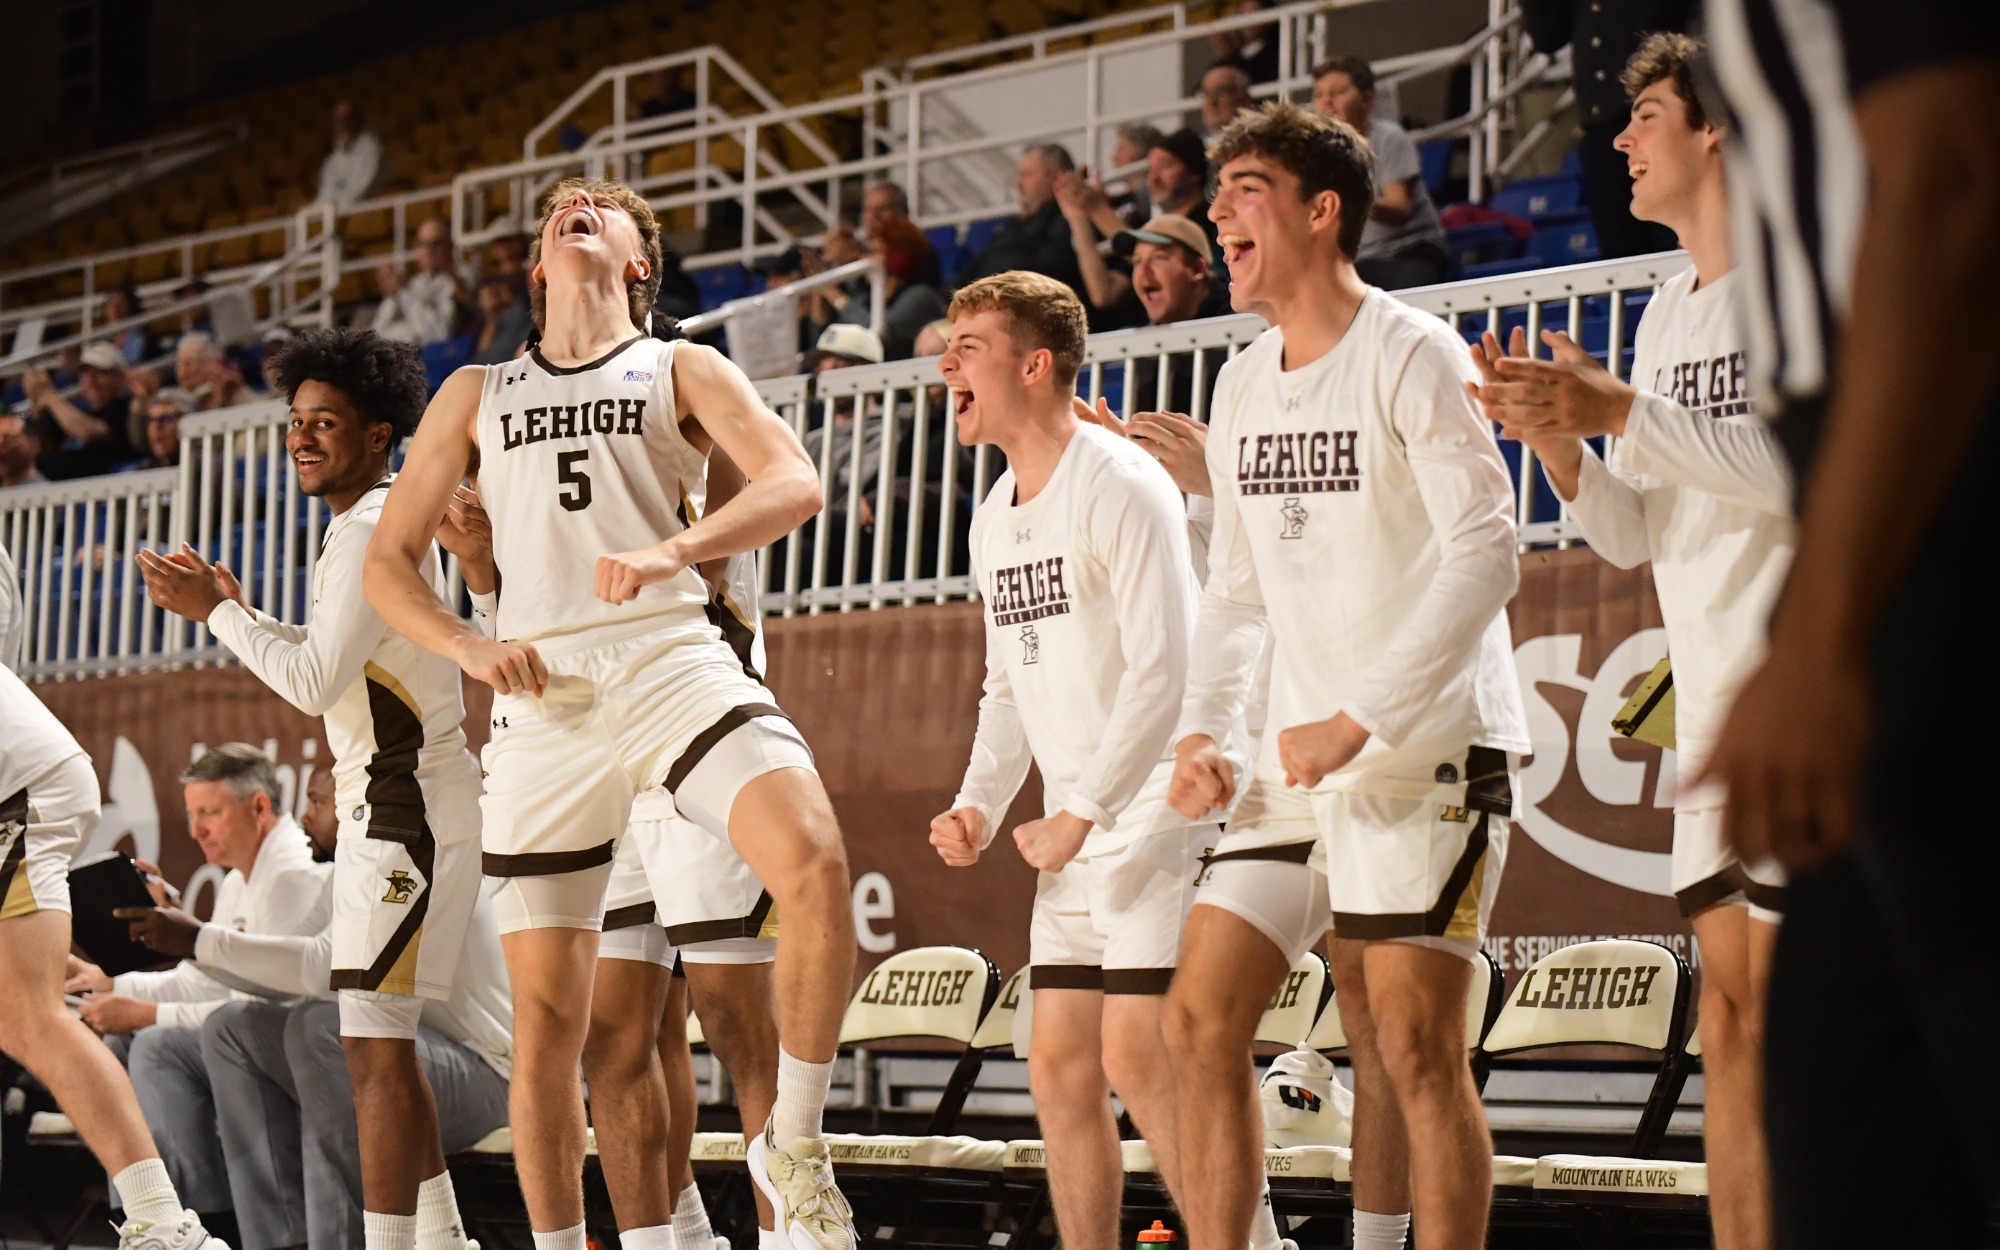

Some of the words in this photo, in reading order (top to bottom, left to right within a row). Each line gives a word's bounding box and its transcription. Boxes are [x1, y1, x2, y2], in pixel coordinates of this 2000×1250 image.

[500, 398, 646, 452] LEHIGH
[1238, 430, 1359, 481] LEHIGH
[557, 449, 592, 512] 5
[990, 557, 1067, 614] LEHIGH
[1484, 936, 1512, 969] HE
[861, 970, 973, 1007] LEHIGH
[1515, 966, 1661, 1010] LEHIGH
[702, 1142, 746, 1156] MOUNTA
[874, 1145, 910, 1159] HAWKS
[1014, 1148, 1046, 1163] MOUN
[1265, 1156, 1293, 1172] WKS
[1552, 1168, 1623, 1187] MOUNTAIN
[1625, 1170, 1677, 1188] HAWKS
